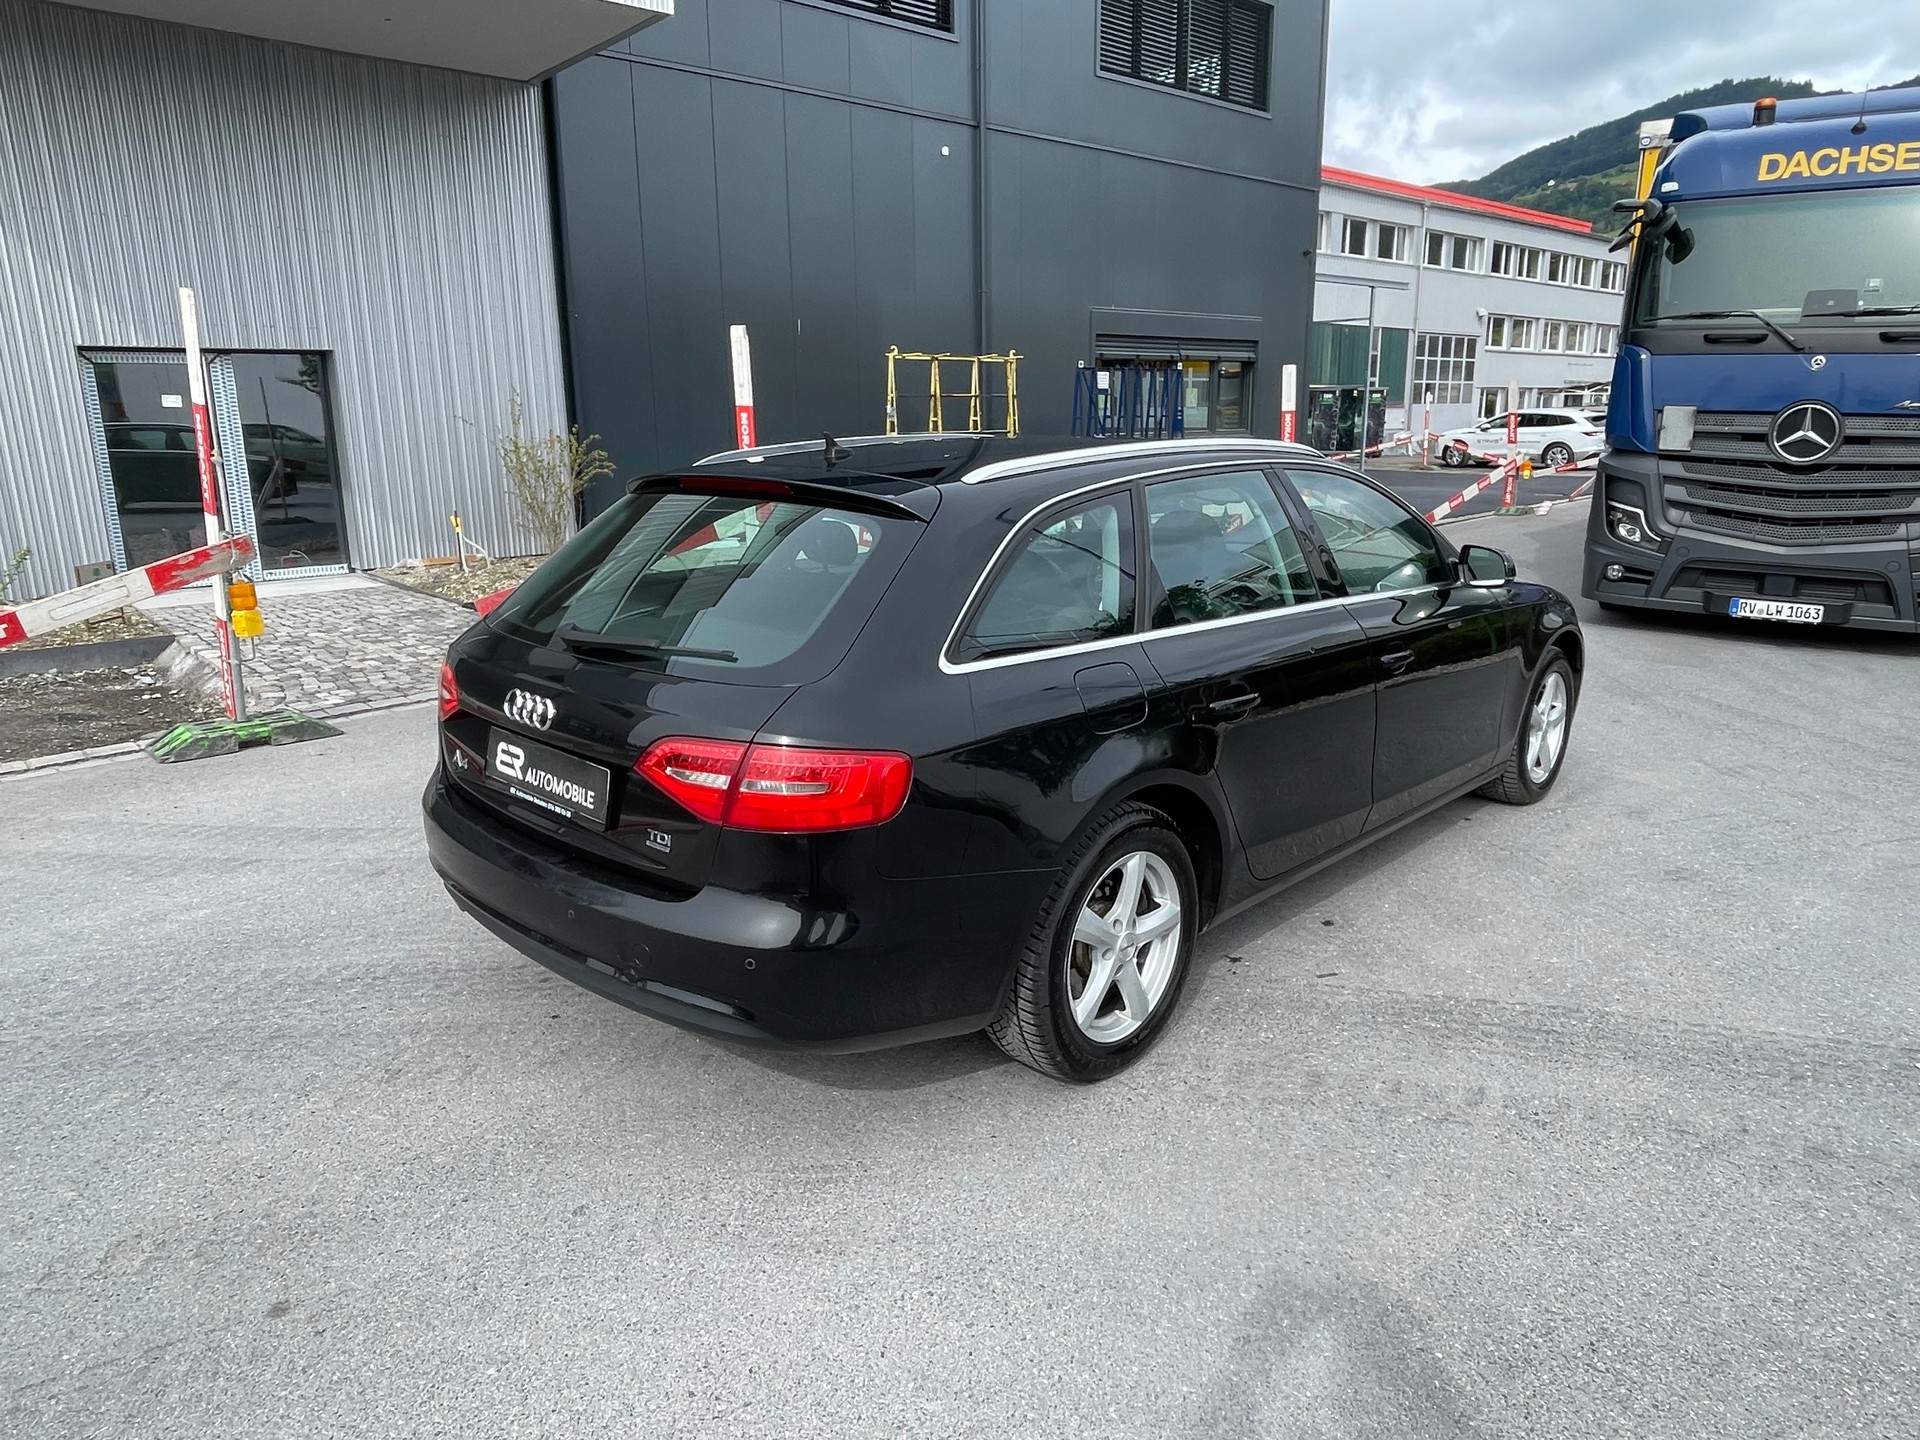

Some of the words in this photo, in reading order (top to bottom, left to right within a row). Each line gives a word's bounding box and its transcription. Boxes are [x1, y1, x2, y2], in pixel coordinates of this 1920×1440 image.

[1757, 141, 1920, 182] DACHSE
[1740, 601, 1757, 614] RV
[1766, 604, 1784, 617] LW
[1786, 606, 1822, 620] 1063
[524, 766, 595, 810] AUTOMOBILE
[647, 828, 671, 847] TDI
